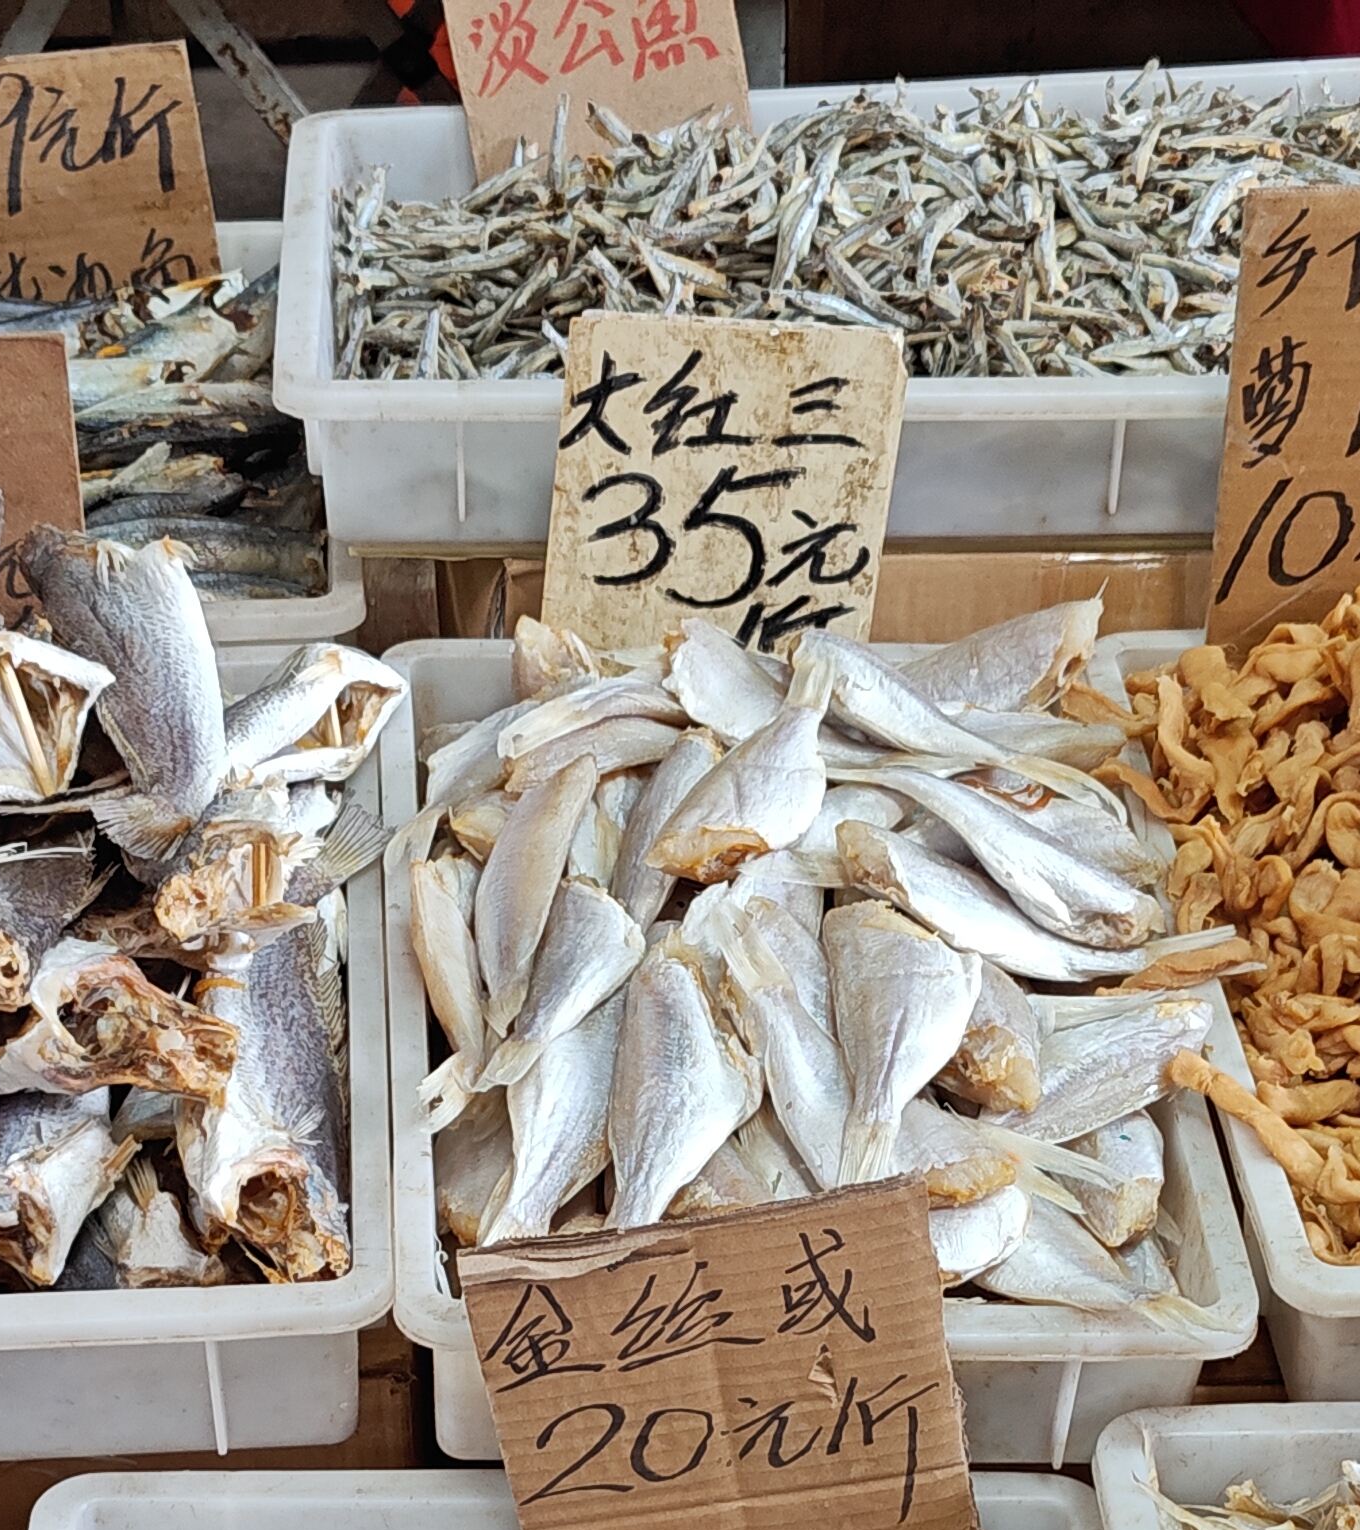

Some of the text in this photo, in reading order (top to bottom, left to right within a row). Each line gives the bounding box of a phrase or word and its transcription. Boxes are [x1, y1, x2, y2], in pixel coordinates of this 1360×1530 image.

[558, 350, 866, 456] 大红三
[582, 465, 871, 608] 35元
